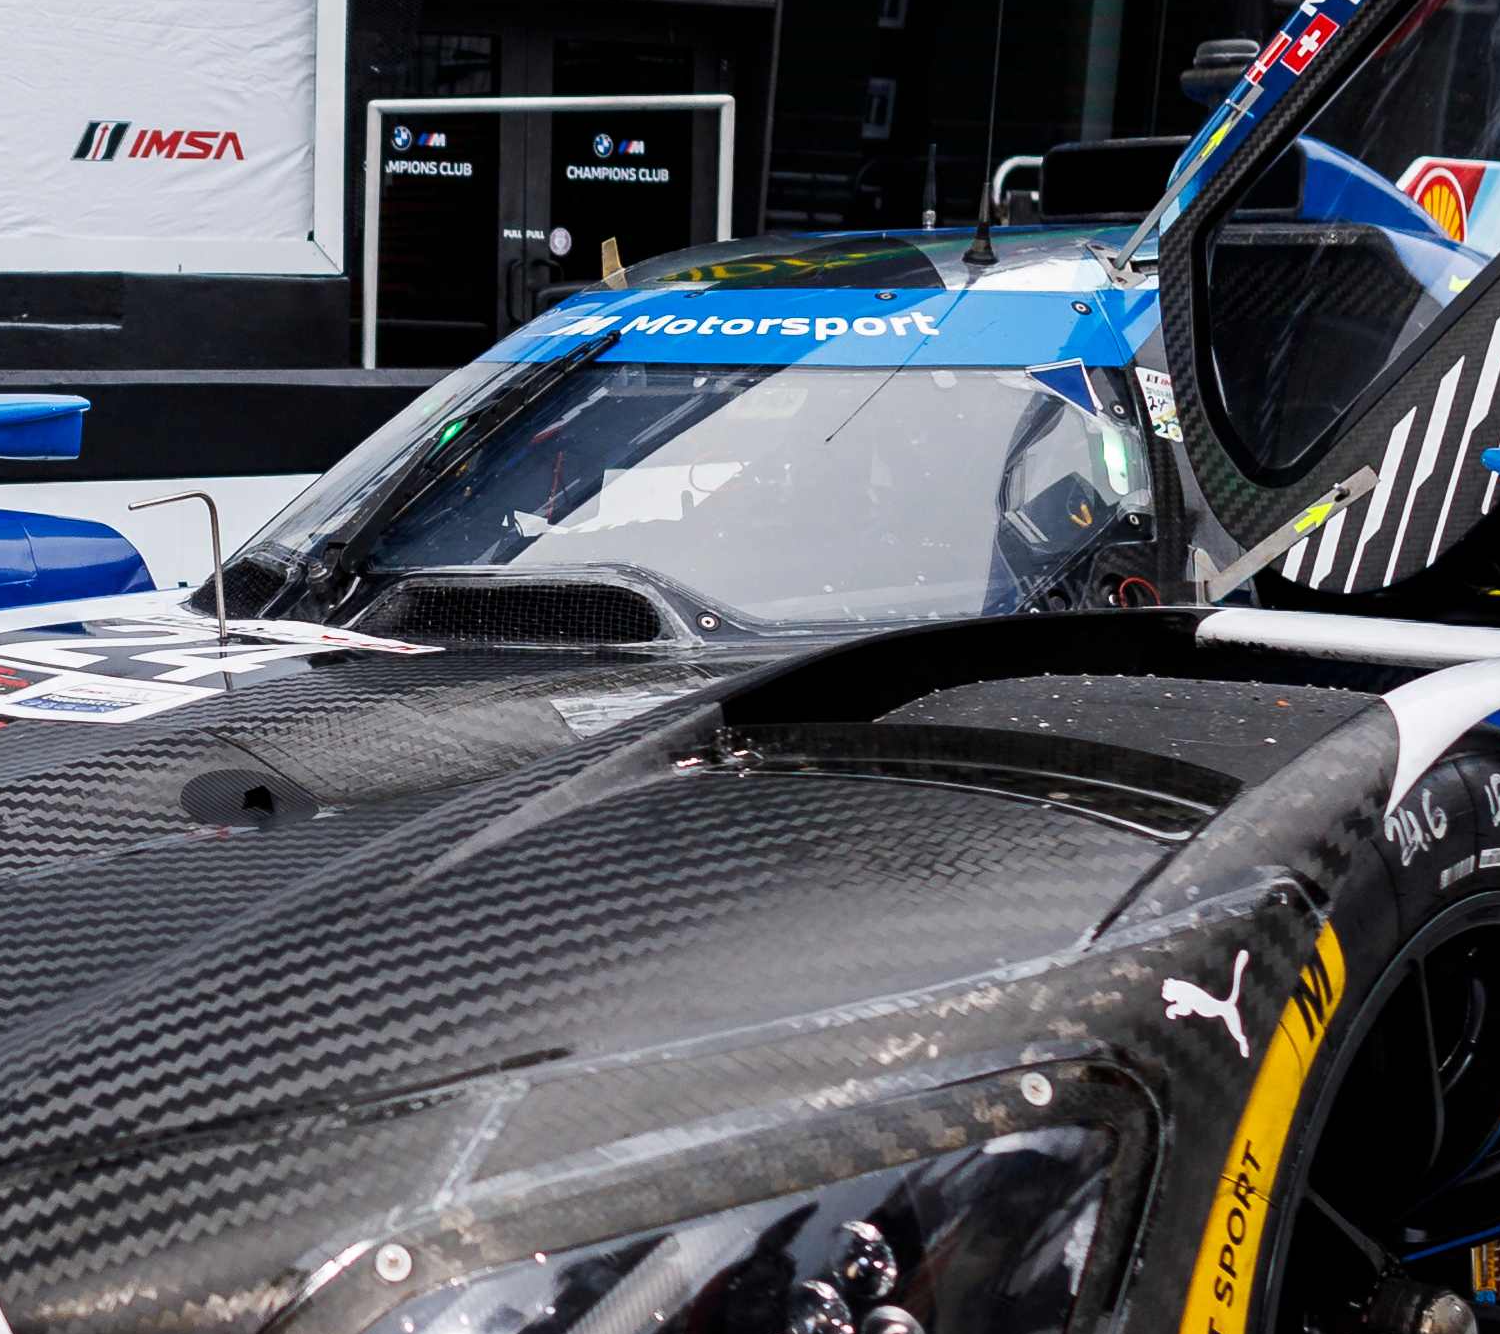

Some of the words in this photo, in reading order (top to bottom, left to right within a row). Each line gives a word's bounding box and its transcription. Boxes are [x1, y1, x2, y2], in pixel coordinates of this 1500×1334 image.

[128, 129, 244, 161] IMSA
[439, 162, 473, 177] CLUB
[566, 165, 637, 182] CHAMPIONS
[638, 168, 669, 182] CLUB
[618, 310, 940, 341] Motorsport
[1213, 1139, 1265, 1308] SPORT
